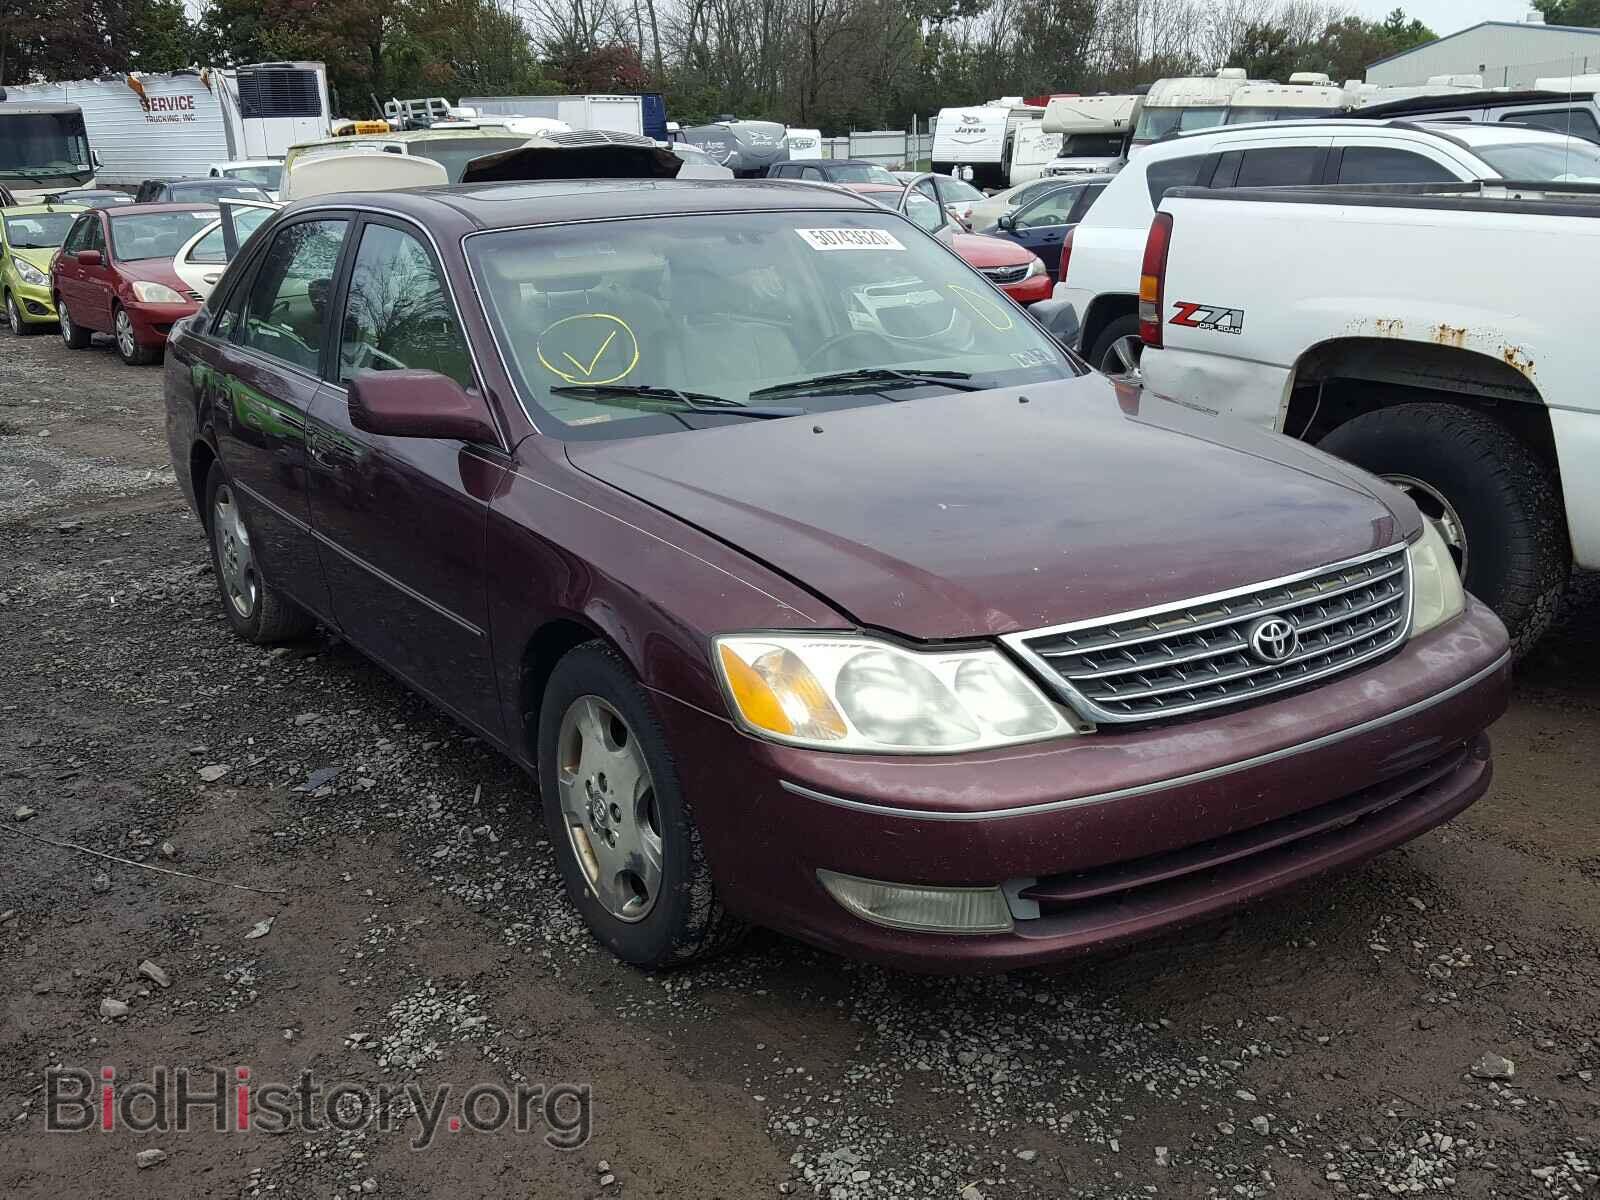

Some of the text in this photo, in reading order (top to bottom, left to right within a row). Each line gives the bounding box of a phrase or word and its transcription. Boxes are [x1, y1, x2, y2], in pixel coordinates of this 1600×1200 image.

[954, 126, 986, 136] Jayco
[1168, 301, 1244, 328] Z71
[1199, 322, 1215, 331] OFF
